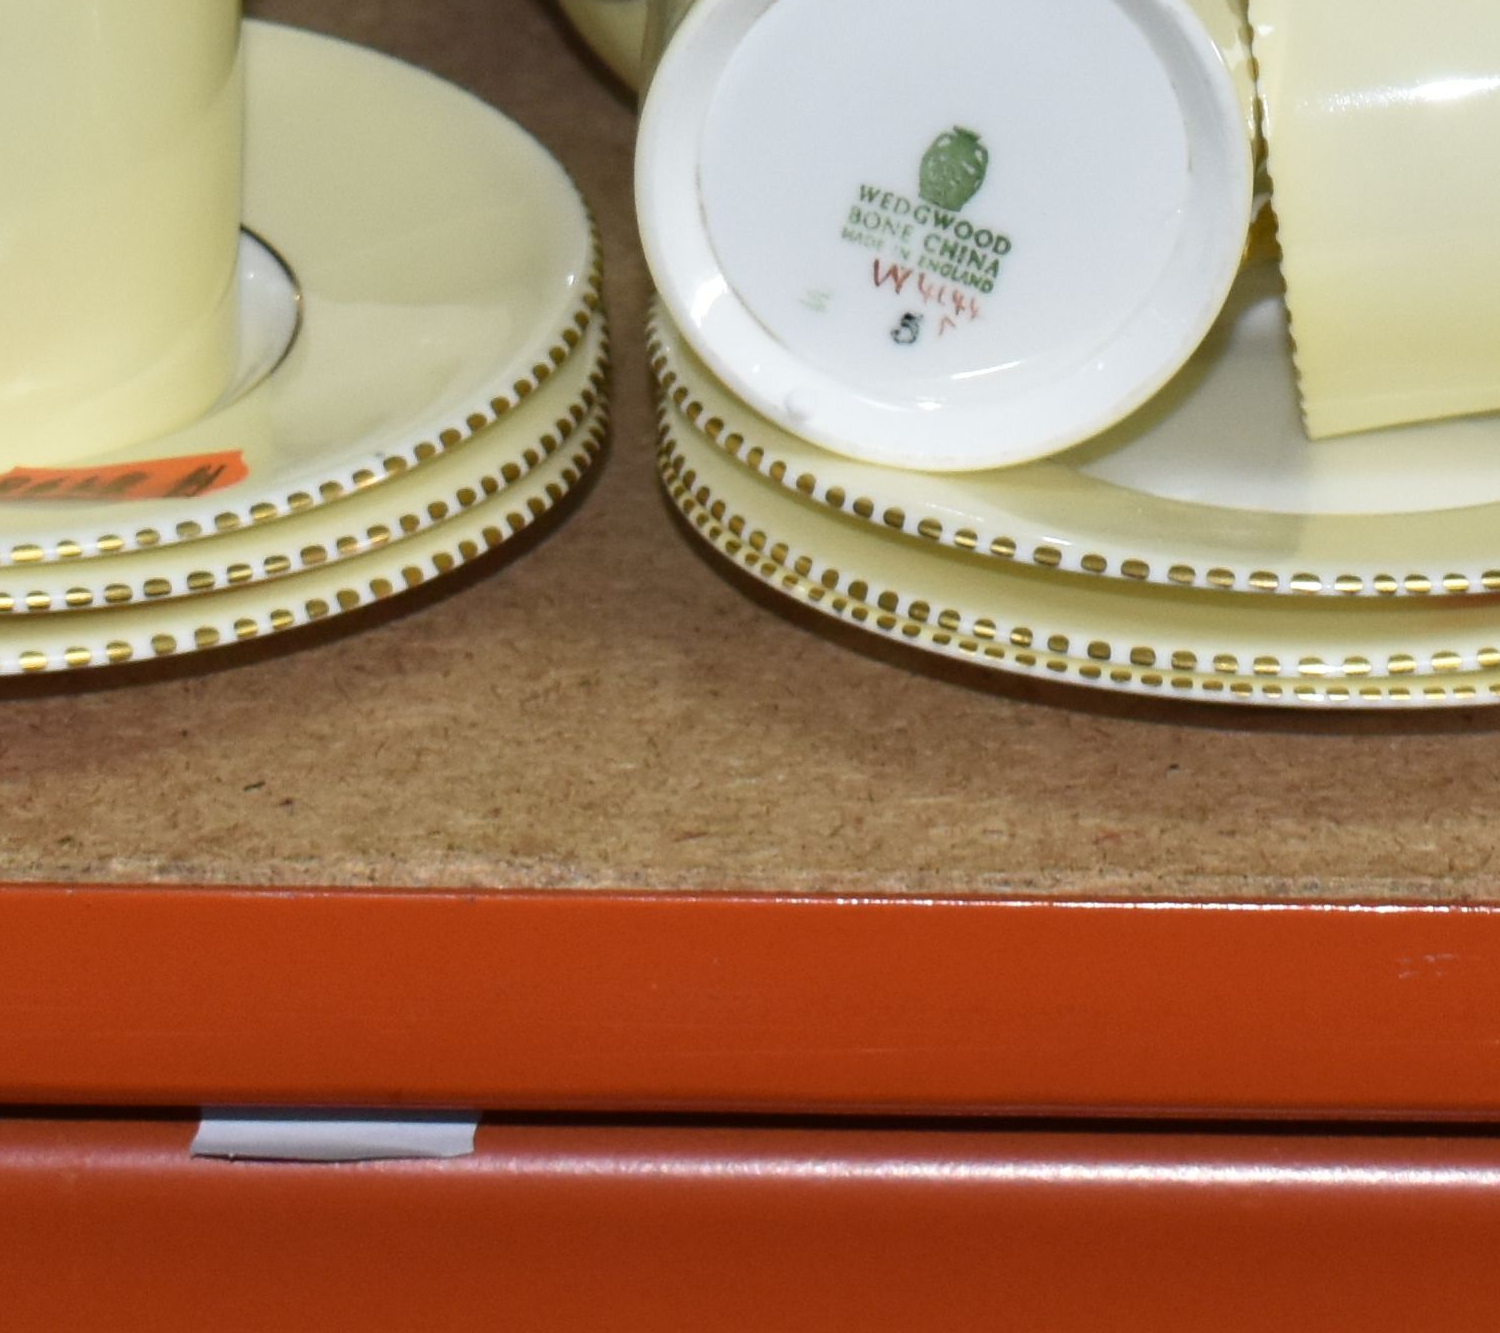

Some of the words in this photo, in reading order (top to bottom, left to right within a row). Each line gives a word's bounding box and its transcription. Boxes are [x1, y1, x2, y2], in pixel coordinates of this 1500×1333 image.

[848, 204, 914, 245] BONE
[922, 232, 1001, 280] CHINA
[858, 183, 1012, 256] WEDGWOOD
[840, 226, 885, 251] MADE
[917, 254, 995, 295] ENGLAND
